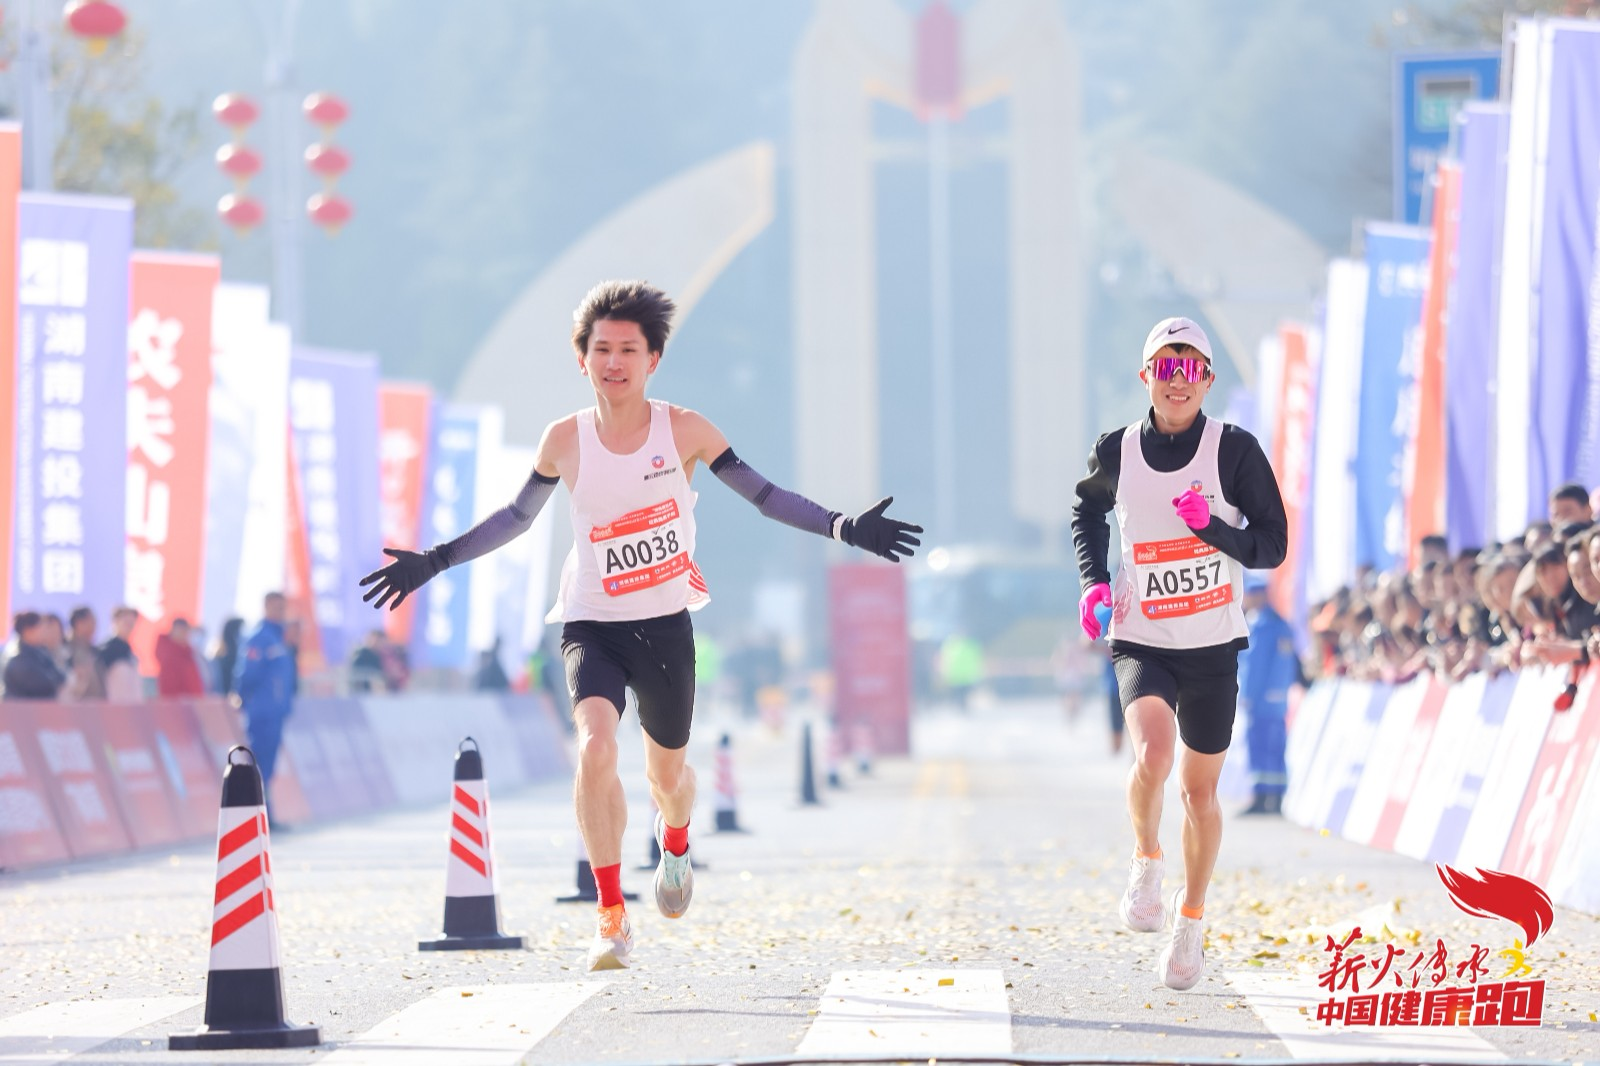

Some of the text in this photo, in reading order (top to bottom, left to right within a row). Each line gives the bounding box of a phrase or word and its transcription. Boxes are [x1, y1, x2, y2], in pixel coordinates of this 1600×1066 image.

[42, 312, 86, 594] 湖南建投集团
[606, 530, 680, 574] A0038
[1145, 560, 1222, 598] A0557
